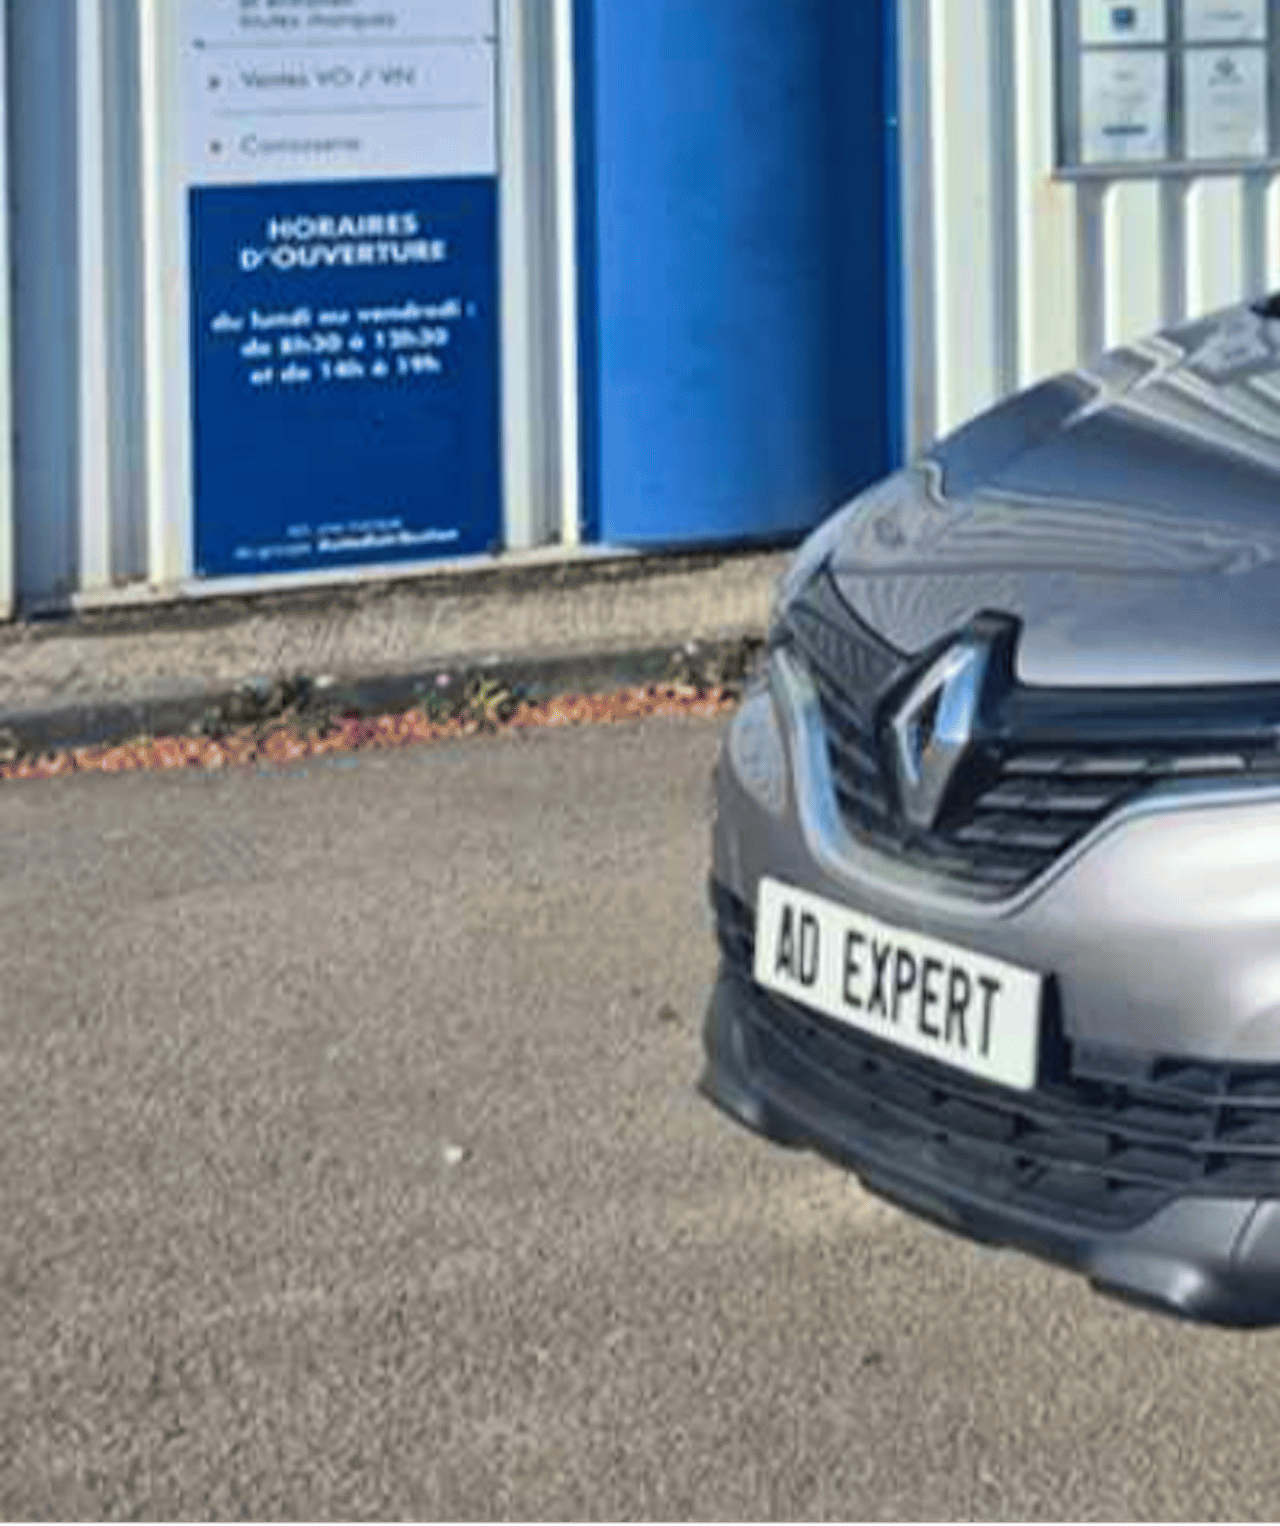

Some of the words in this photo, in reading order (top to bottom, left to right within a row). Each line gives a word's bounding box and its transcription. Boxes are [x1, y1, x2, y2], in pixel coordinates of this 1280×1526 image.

[267, 212, 419, 241] HORAIRES
[241, 239, 447, 271] D'OUVERTURE
[251, 308, 312, 329] lundi
[356, 299, 461, 322] vendredi
[775, 903, 820, 988] AD
[842, 929, 1002, 1059] EXPERT
